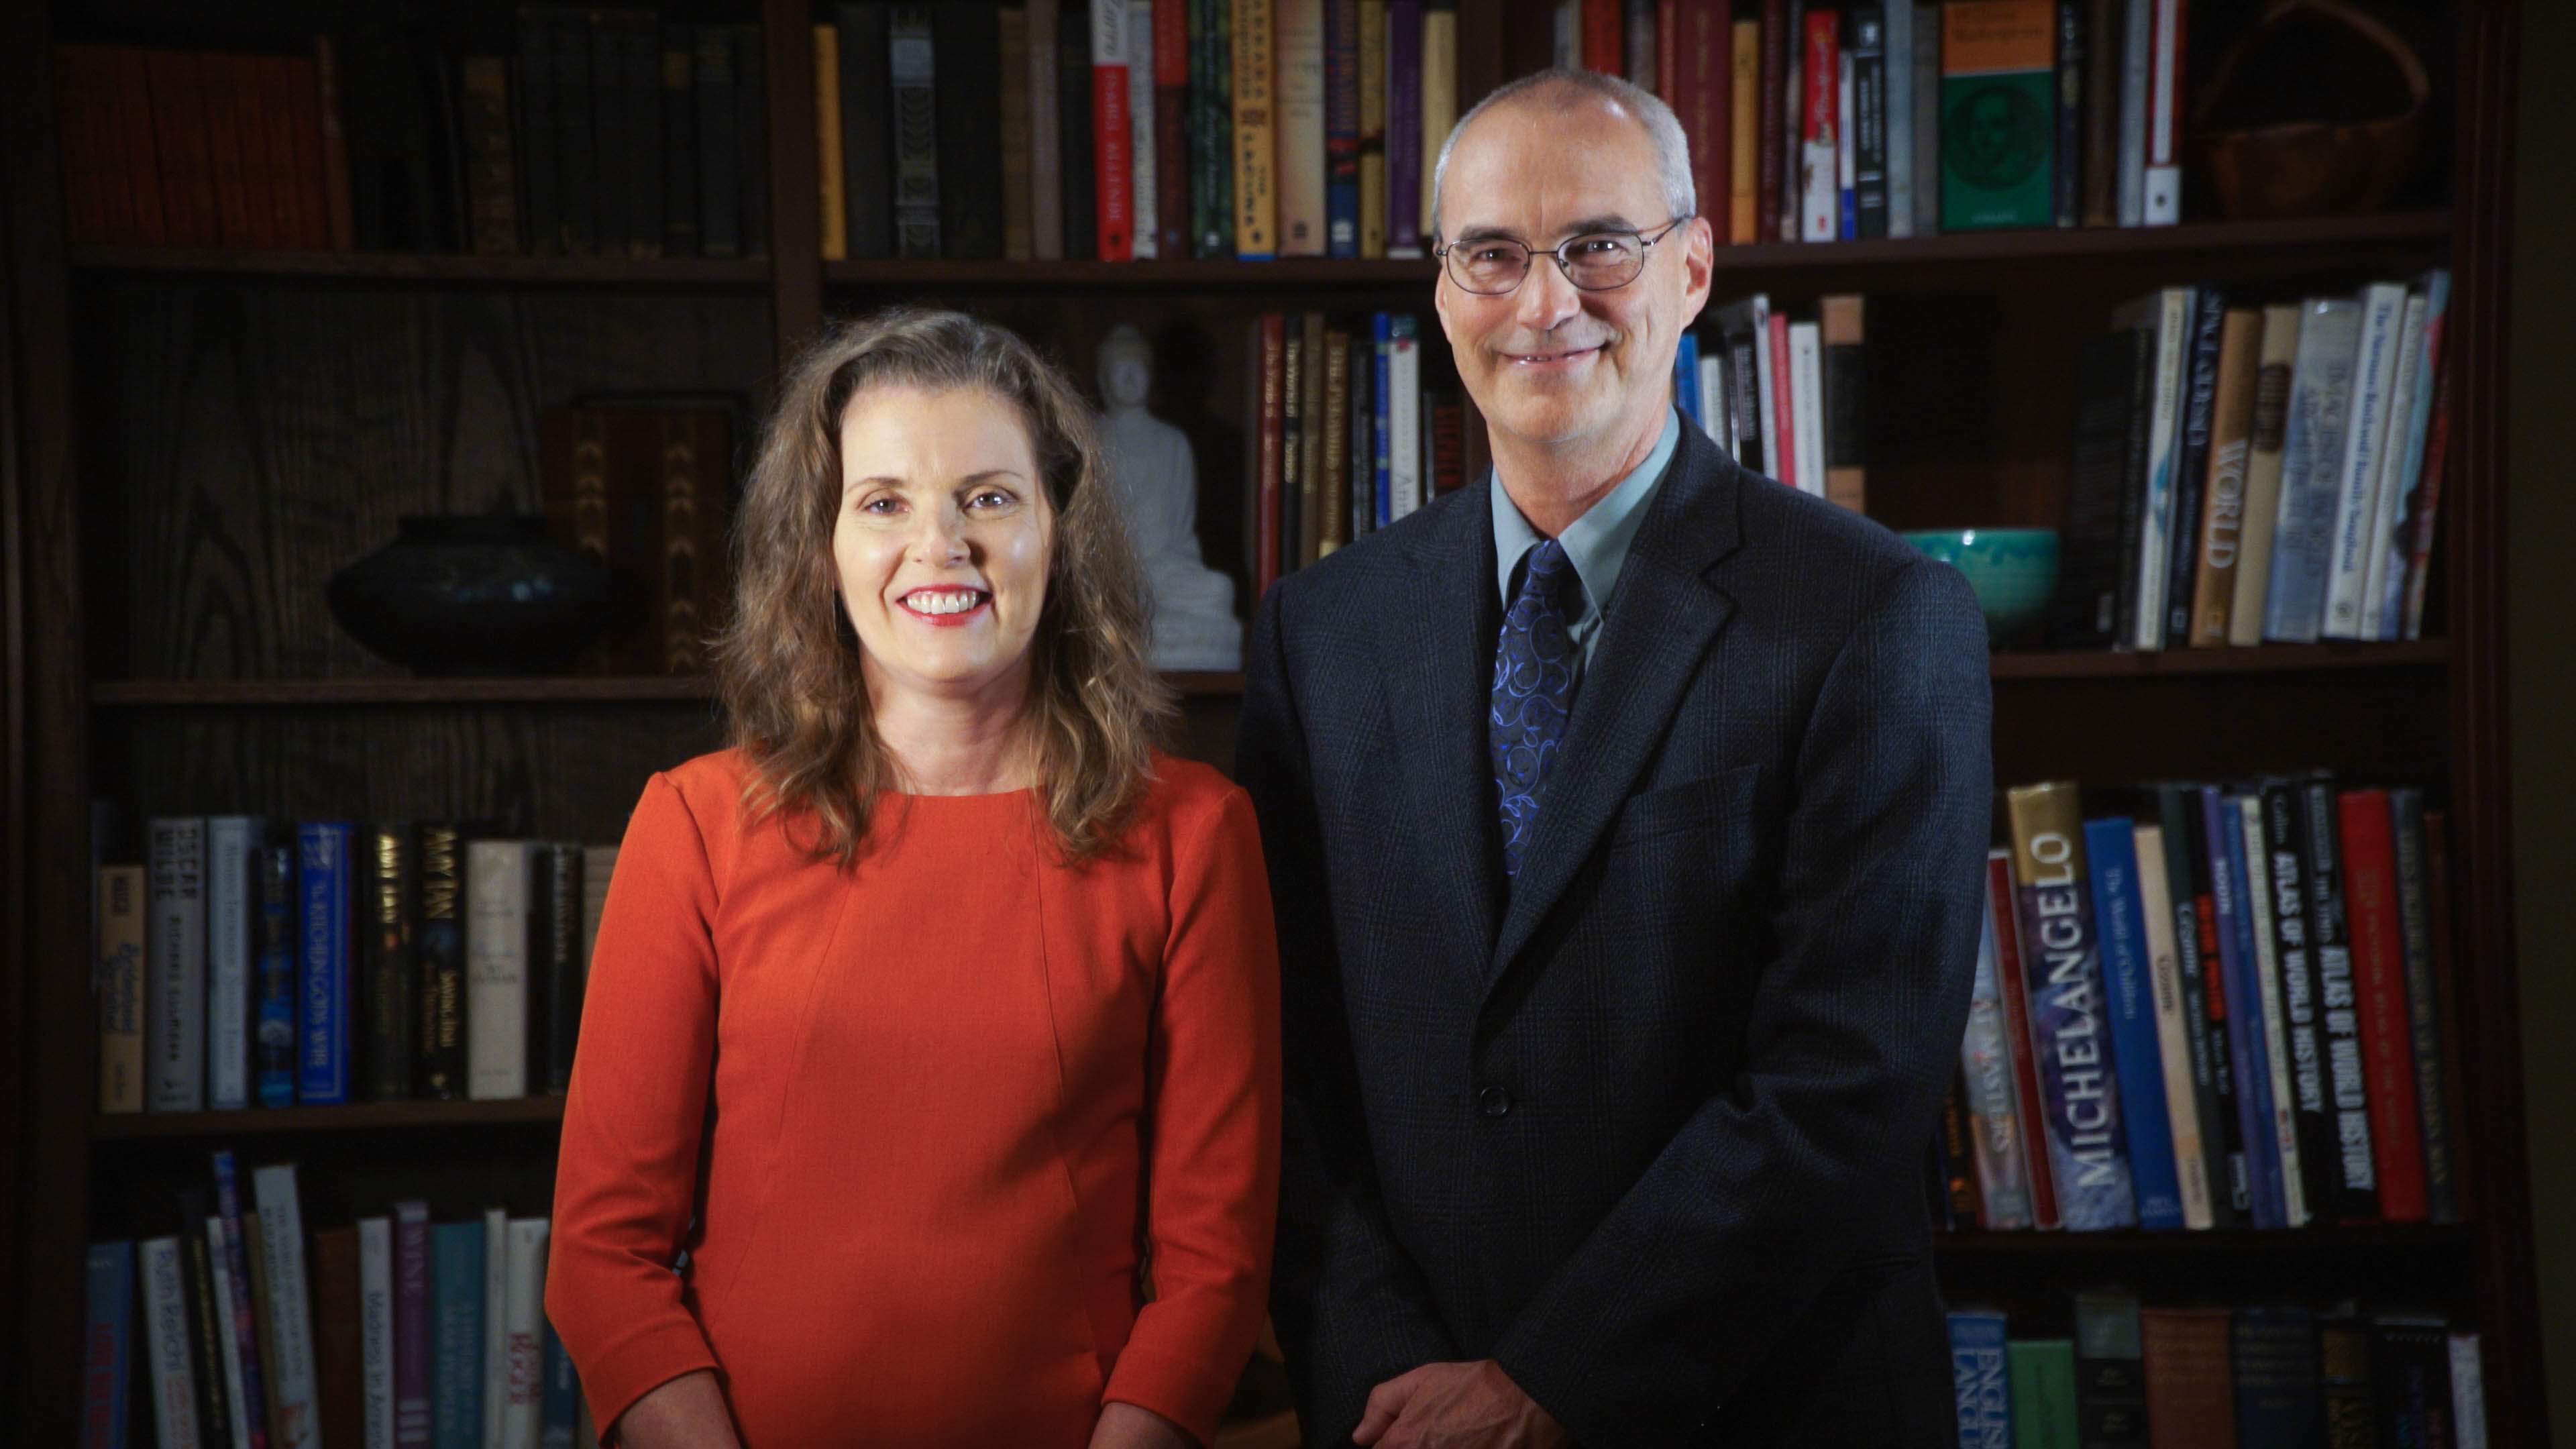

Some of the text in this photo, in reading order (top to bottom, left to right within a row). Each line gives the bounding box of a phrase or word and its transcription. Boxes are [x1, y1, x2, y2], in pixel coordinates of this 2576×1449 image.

[2206, 439, 2249, 570] WORLD
[154, 830, 173, 901] WILDE
[421, 826, 461, 920] AMY TAN
[2271, 851, 2299, 916] ATLAS
[2278, 917, 2304, 947] OF
[2030, 831, 2116, 1188] MICHELANGELO
[2283, 951, 2314, 1024] WORLD
[2318, 945, 2356, 1008] ATLAS
[2325, 1008, 2360, 1039] OF
[2290, 1025, 2323, 1114] HISTORY
[2328, 1041, 2367, 1110] WORLD
[2337, 1111, 2377, 1193] HISTORY
[1952, 1347, 1980, 1449] LANGU
[1977, 1347, 2008, 1449] ENGLIS
